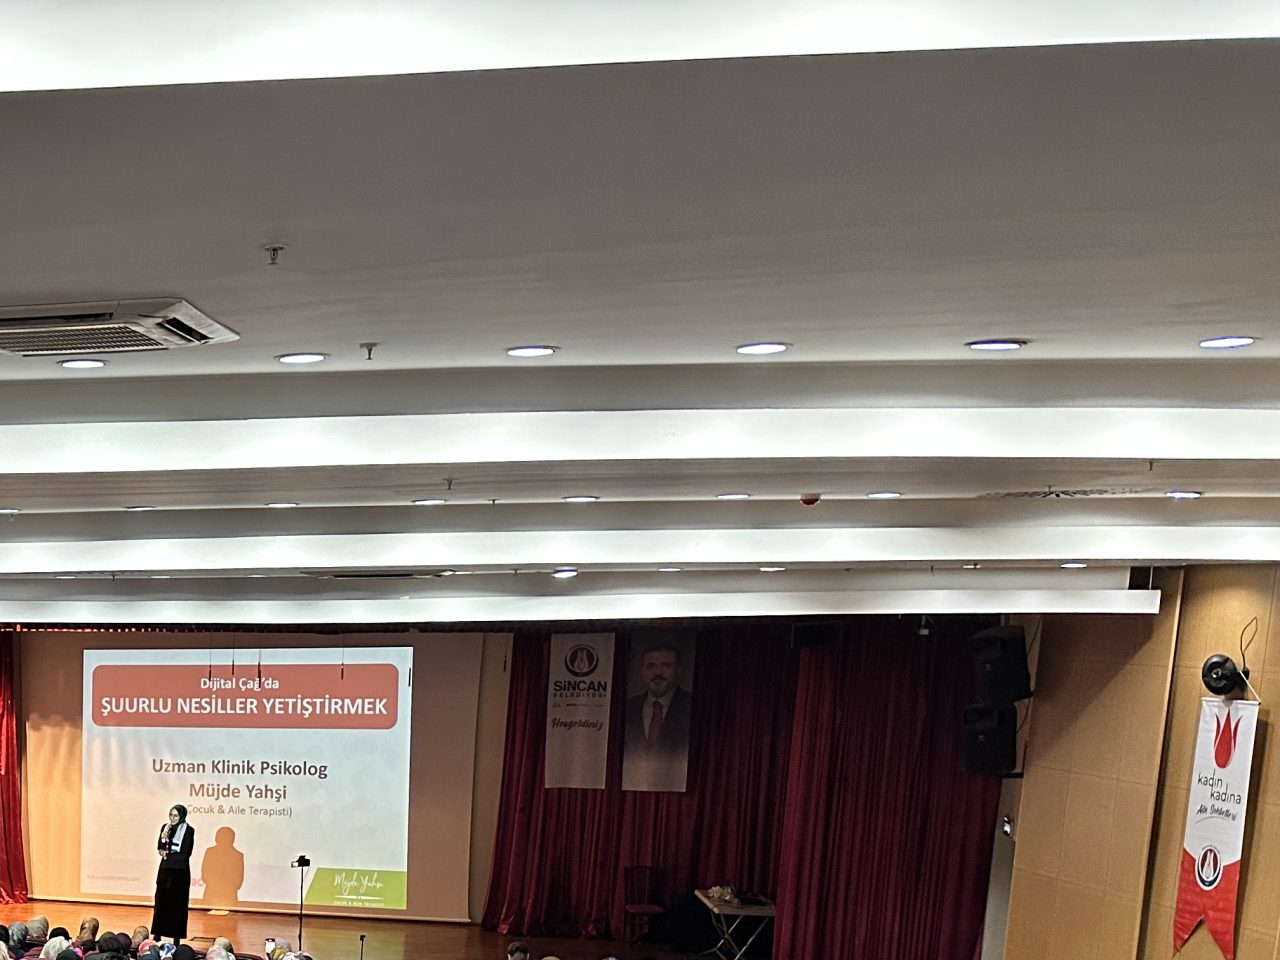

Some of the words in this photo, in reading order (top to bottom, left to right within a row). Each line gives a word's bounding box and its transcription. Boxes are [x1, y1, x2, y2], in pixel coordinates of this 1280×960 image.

[200, 677, 236, 691] Dijital
[101, 696, 173, 716] ŞUURLU
[177, 694, 258, 714] NESİLLER
[262, 694, 388, 718] YETİŞTİRMEK
[152, 759, 206, 774] Uzman
[211, 760, 256, 775] Klinik
[260, 760, 328, 779] Psikolog
[189, 783, 241, 801] Müjde
[246, 784, 287, 802] Yahşi
[1210, 782, 1241, 804] kadına
[187, 804, 215, 815] Çocuk
[217, 804, 225, 814] &
[227, 804, 246, 815] Aile
[249, 806, 293, 818] Terapisti)
